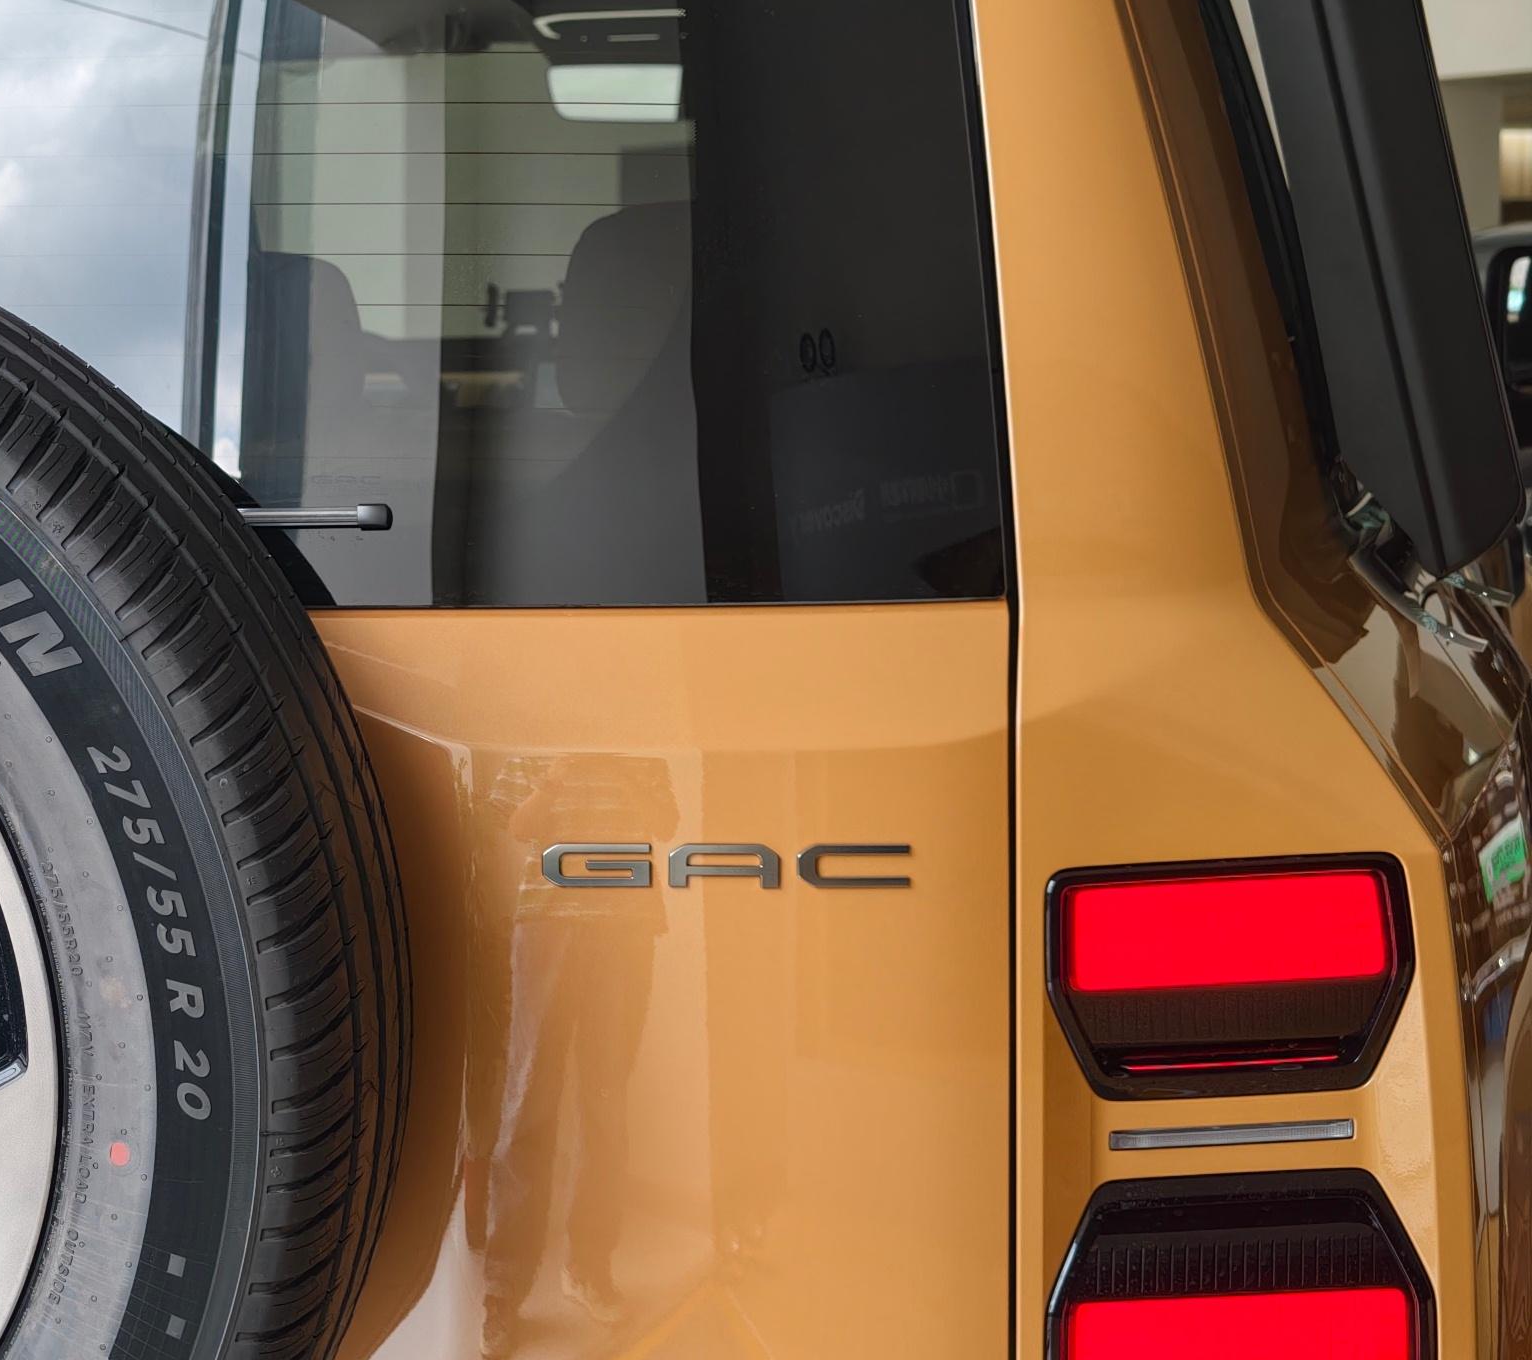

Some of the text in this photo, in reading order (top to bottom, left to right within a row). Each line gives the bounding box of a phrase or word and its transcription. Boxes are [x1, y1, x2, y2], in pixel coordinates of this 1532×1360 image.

[85, 742, 210, 1122] 275/55 R 20
[541, 841, 913, 889] GAC
